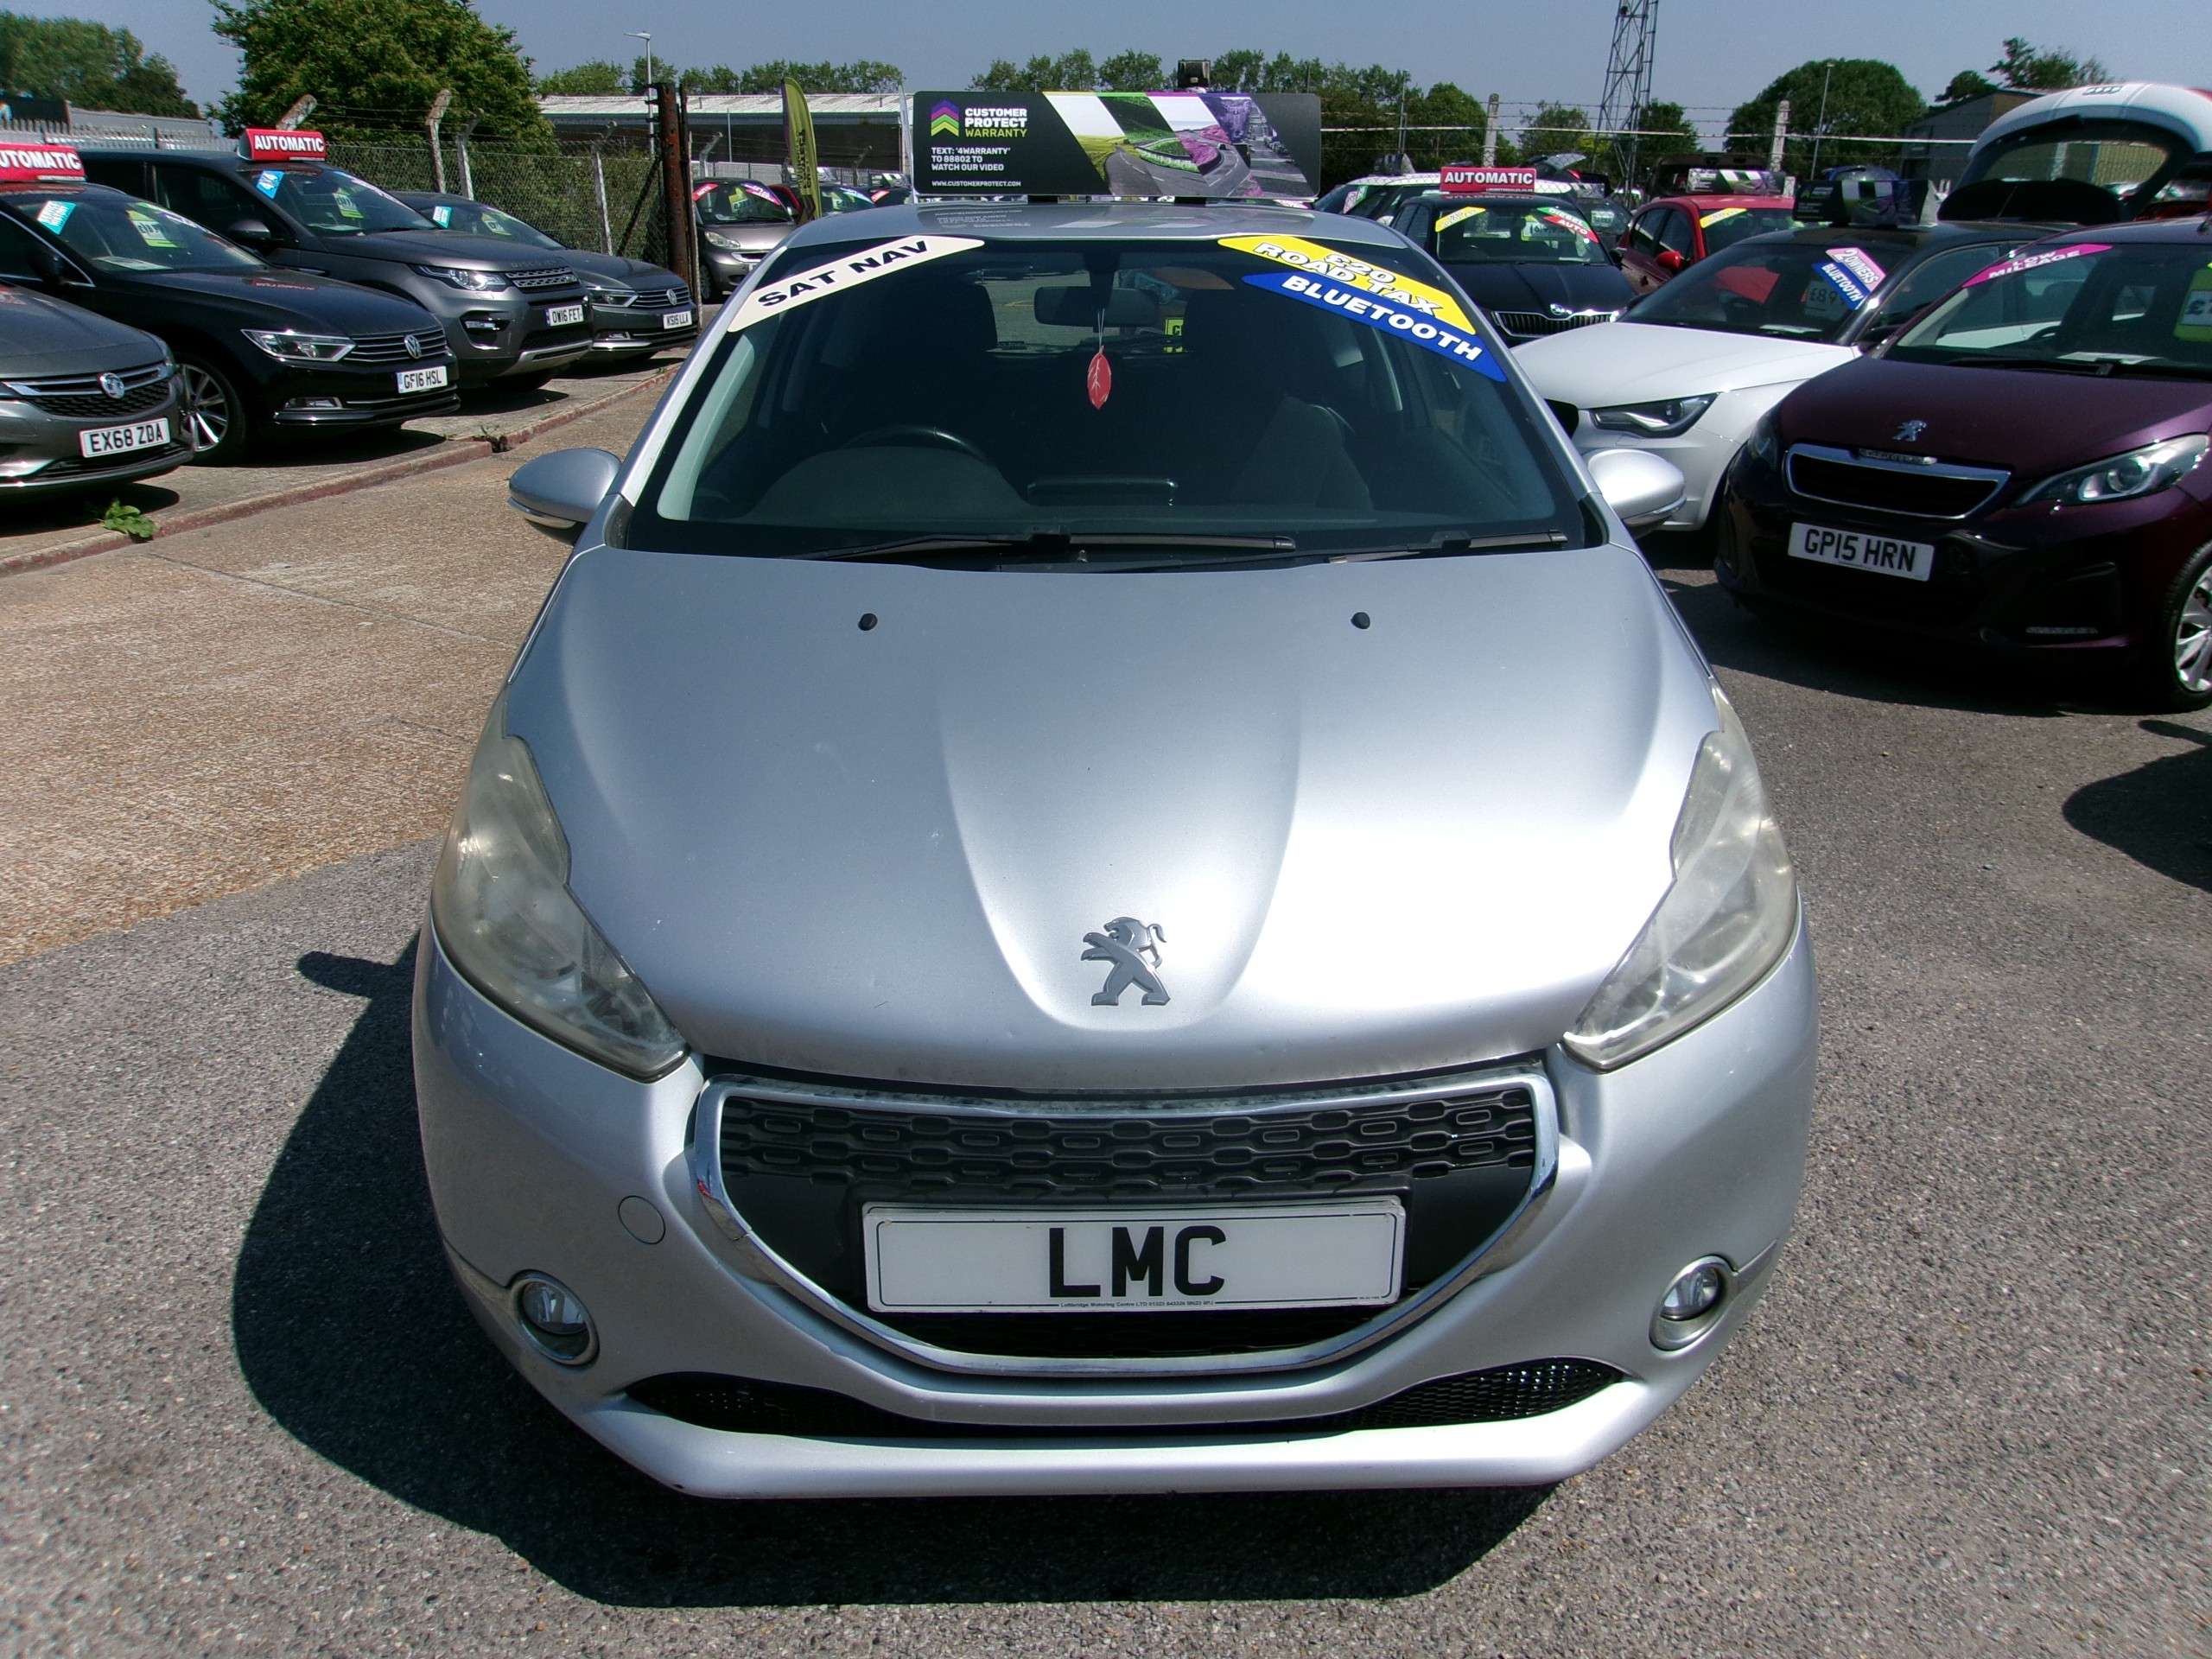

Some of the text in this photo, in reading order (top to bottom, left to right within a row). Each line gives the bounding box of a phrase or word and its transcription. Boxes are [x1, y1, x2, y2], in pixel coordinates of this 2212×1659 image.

[965, 108, 1027, 117] CUSTOMER
[965, 118, 1027, 128] PROTECT
[254, 135, 324, 152] AUTOMATIC
[965, 129, 1027, 137] WARRANTY
[0, 150, 82, 169] UTOMATIC
[1445, 172, 1533, 184] AUTOMATIC
[1559, 219, 1587, 235] AUTO
[1323, 253, 1396, 283] £20
[1989, 251, 2081, 278] MILEAGE
[2012, 251, 2057, 267] LOW
[758, 240, 928, 307] SAT NAV
[1253, 242, 1444, 318] ROAD TAX
[1821, 263, 1865, 302] BLUETOOTH
[1281, 275, 1483, 361] BLUETOOTH
[425, 370, 442, 385] HSL
[90, 429, 133, 453] EX68
[1804, 528, 1916, 572] GP15 HRN
[1049, 1225, 1226, 1297] LMC
